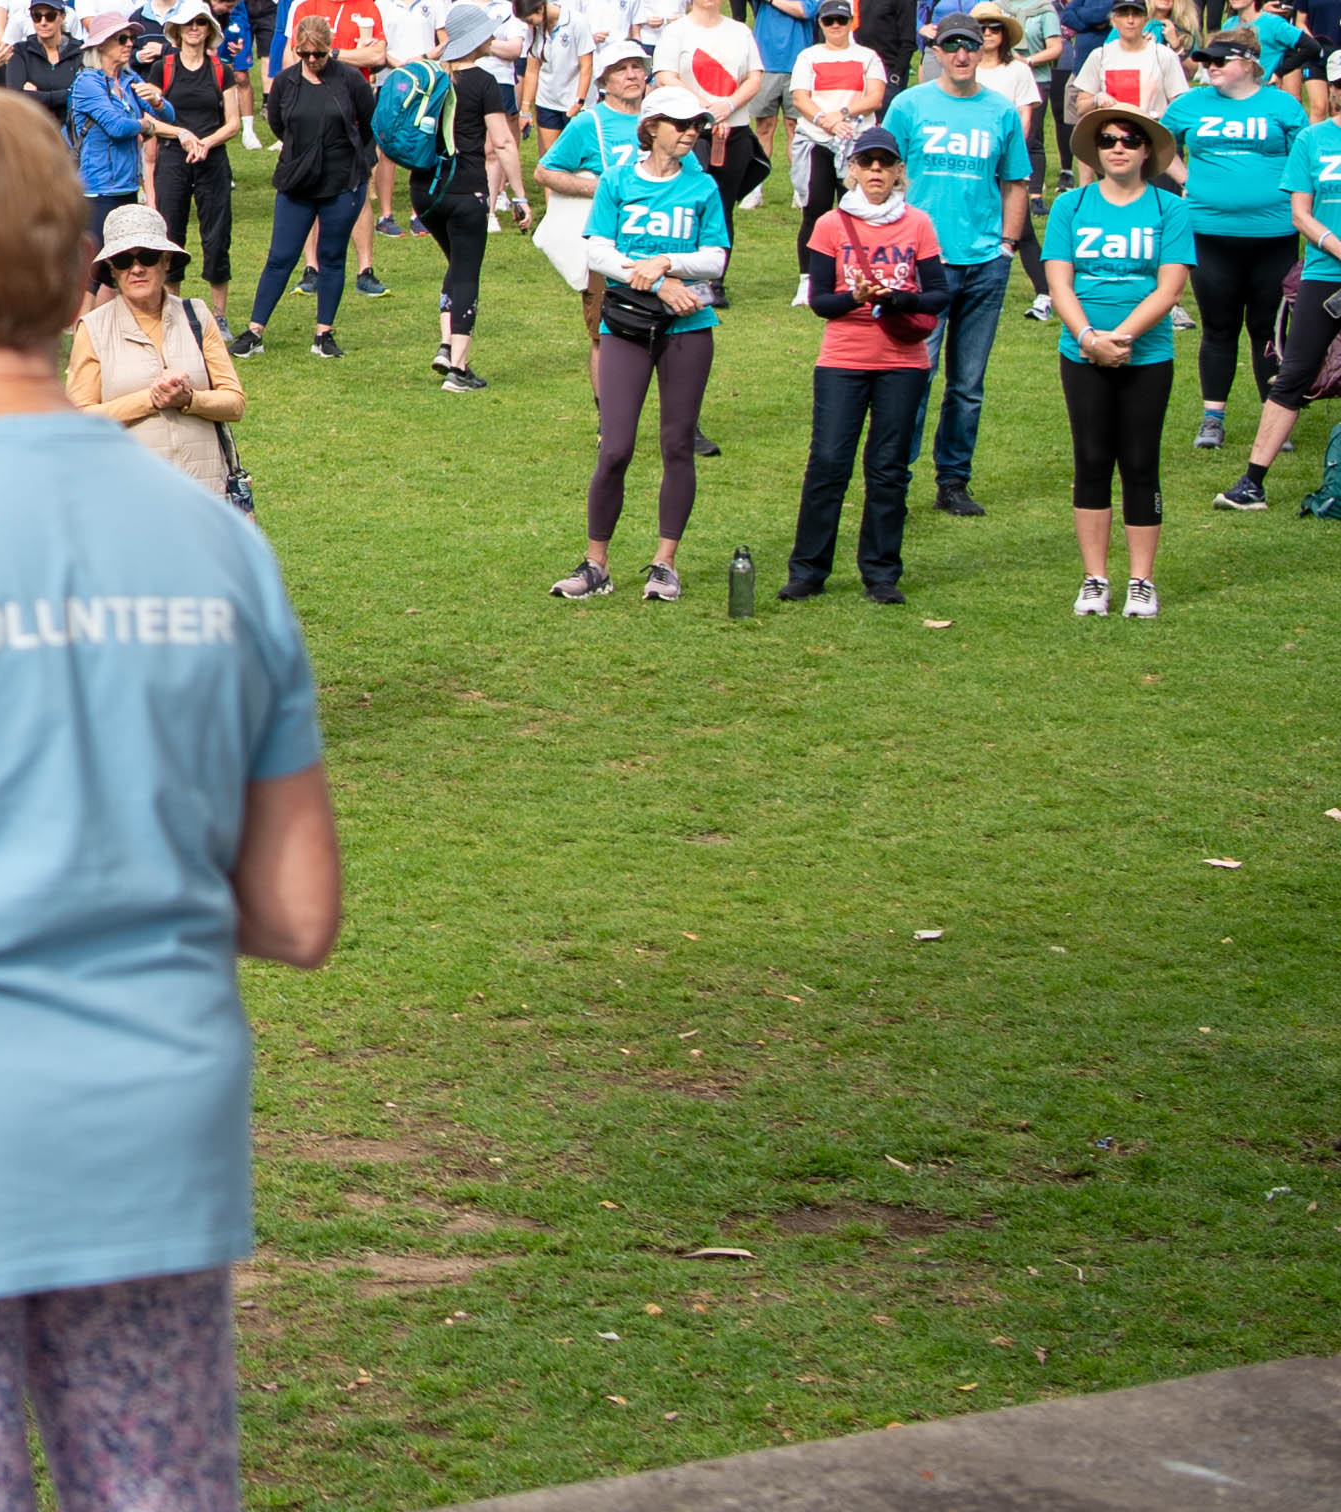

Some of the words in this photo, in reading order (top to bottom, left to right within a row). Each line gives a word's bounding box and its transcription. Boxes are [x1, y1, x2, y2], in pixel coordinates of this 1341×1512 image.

[922, 126, 990, 158] Zali
[1197, 116, 1267, 140] Zali
[621, 204, 695, 239] Zali
[1075, 227, 1154, 259] Zali
